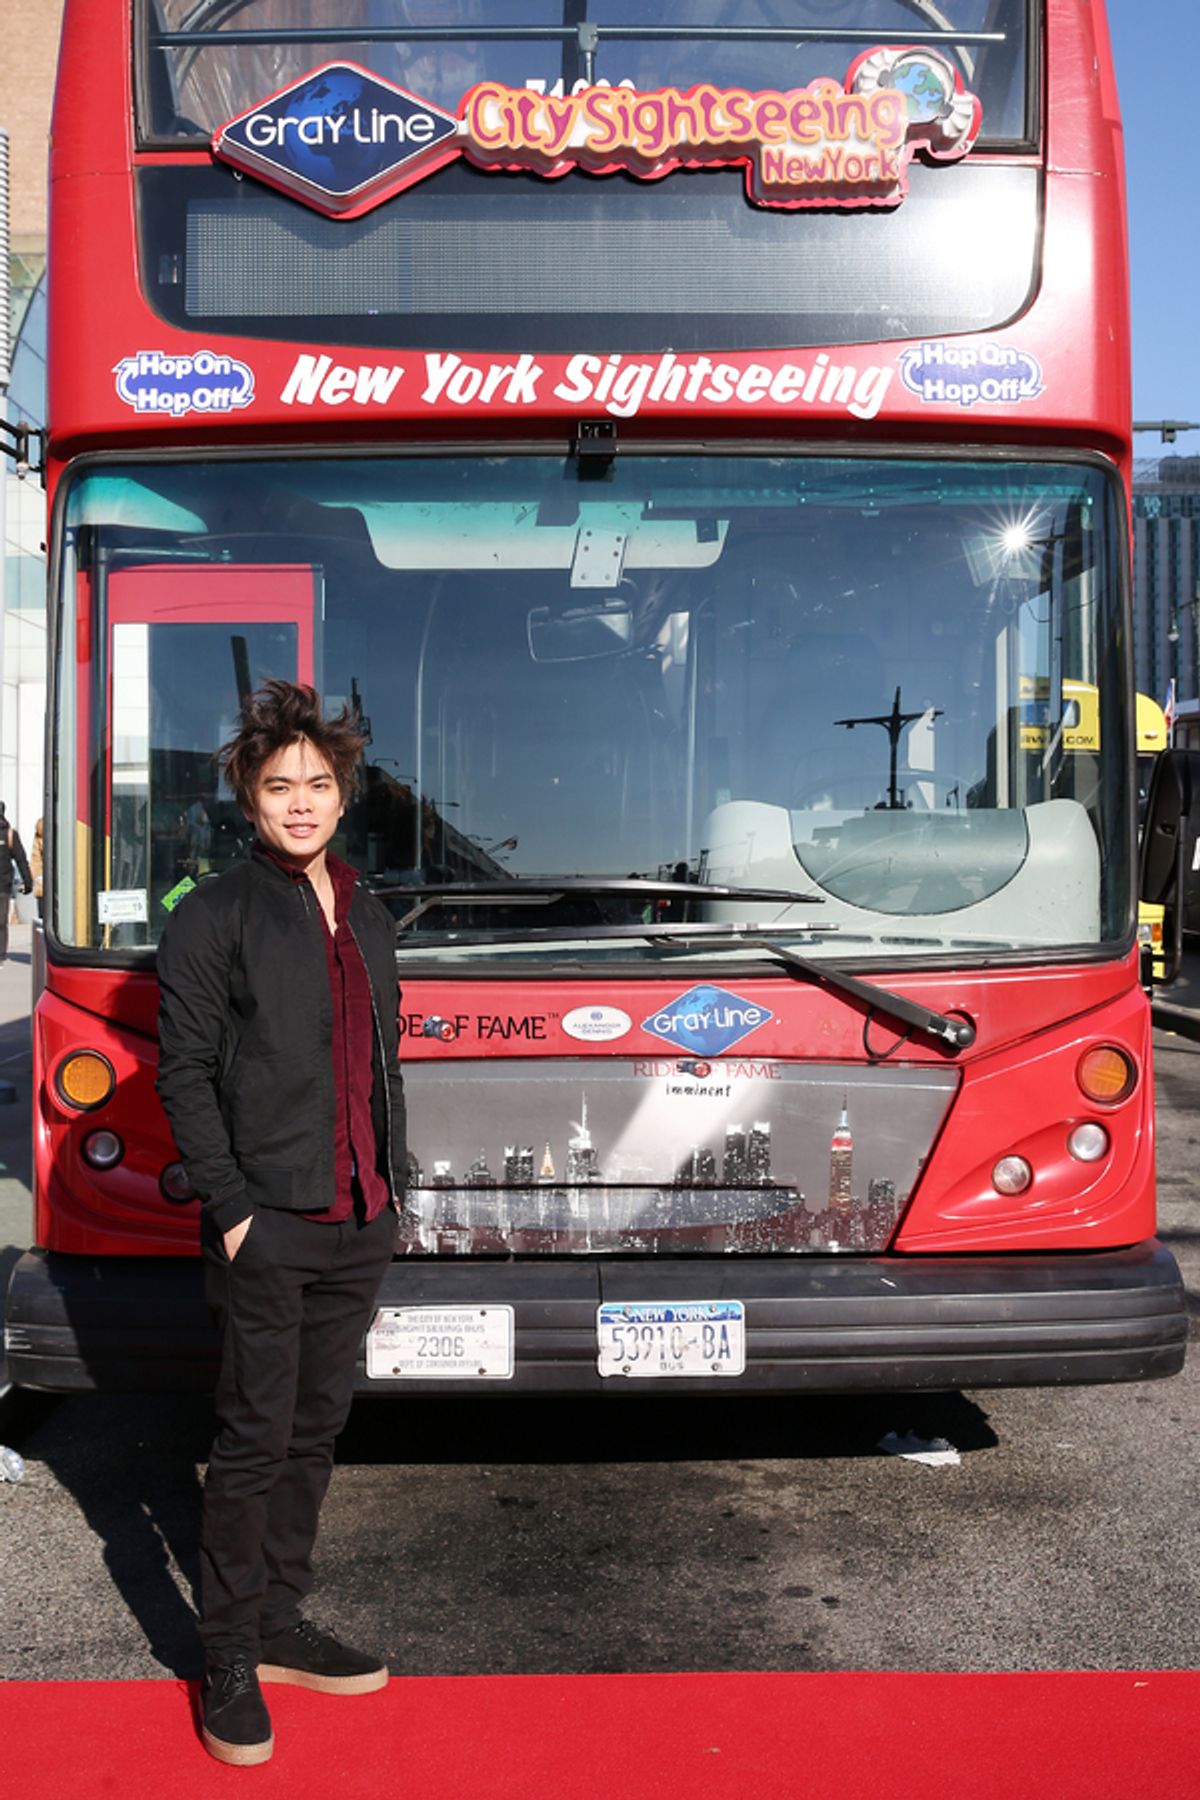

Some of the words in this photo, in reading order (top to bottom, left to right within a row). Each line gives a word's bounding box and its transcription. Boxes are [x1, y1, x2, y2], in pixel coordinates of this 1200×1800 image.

[139, 354, 193, 379] Hop
[194, 353, 231, 375] On
[922, 343, 977, 369] Hop
[979, 343, 1018, 366] On
[280, 354, 404, 405] New
[421, 353, 543, 405] York
[553, 352, 894, 420] Sightseeing
[923, 378, 978, 403] Hop
[979, 377, 1020, 401] Off
[137, 388, 191, 413] Hop
[192, 387, 231, 408] Off
[725, 1062, 782, 1080] FAME
[417, 1336, 465, 1357] 2306
